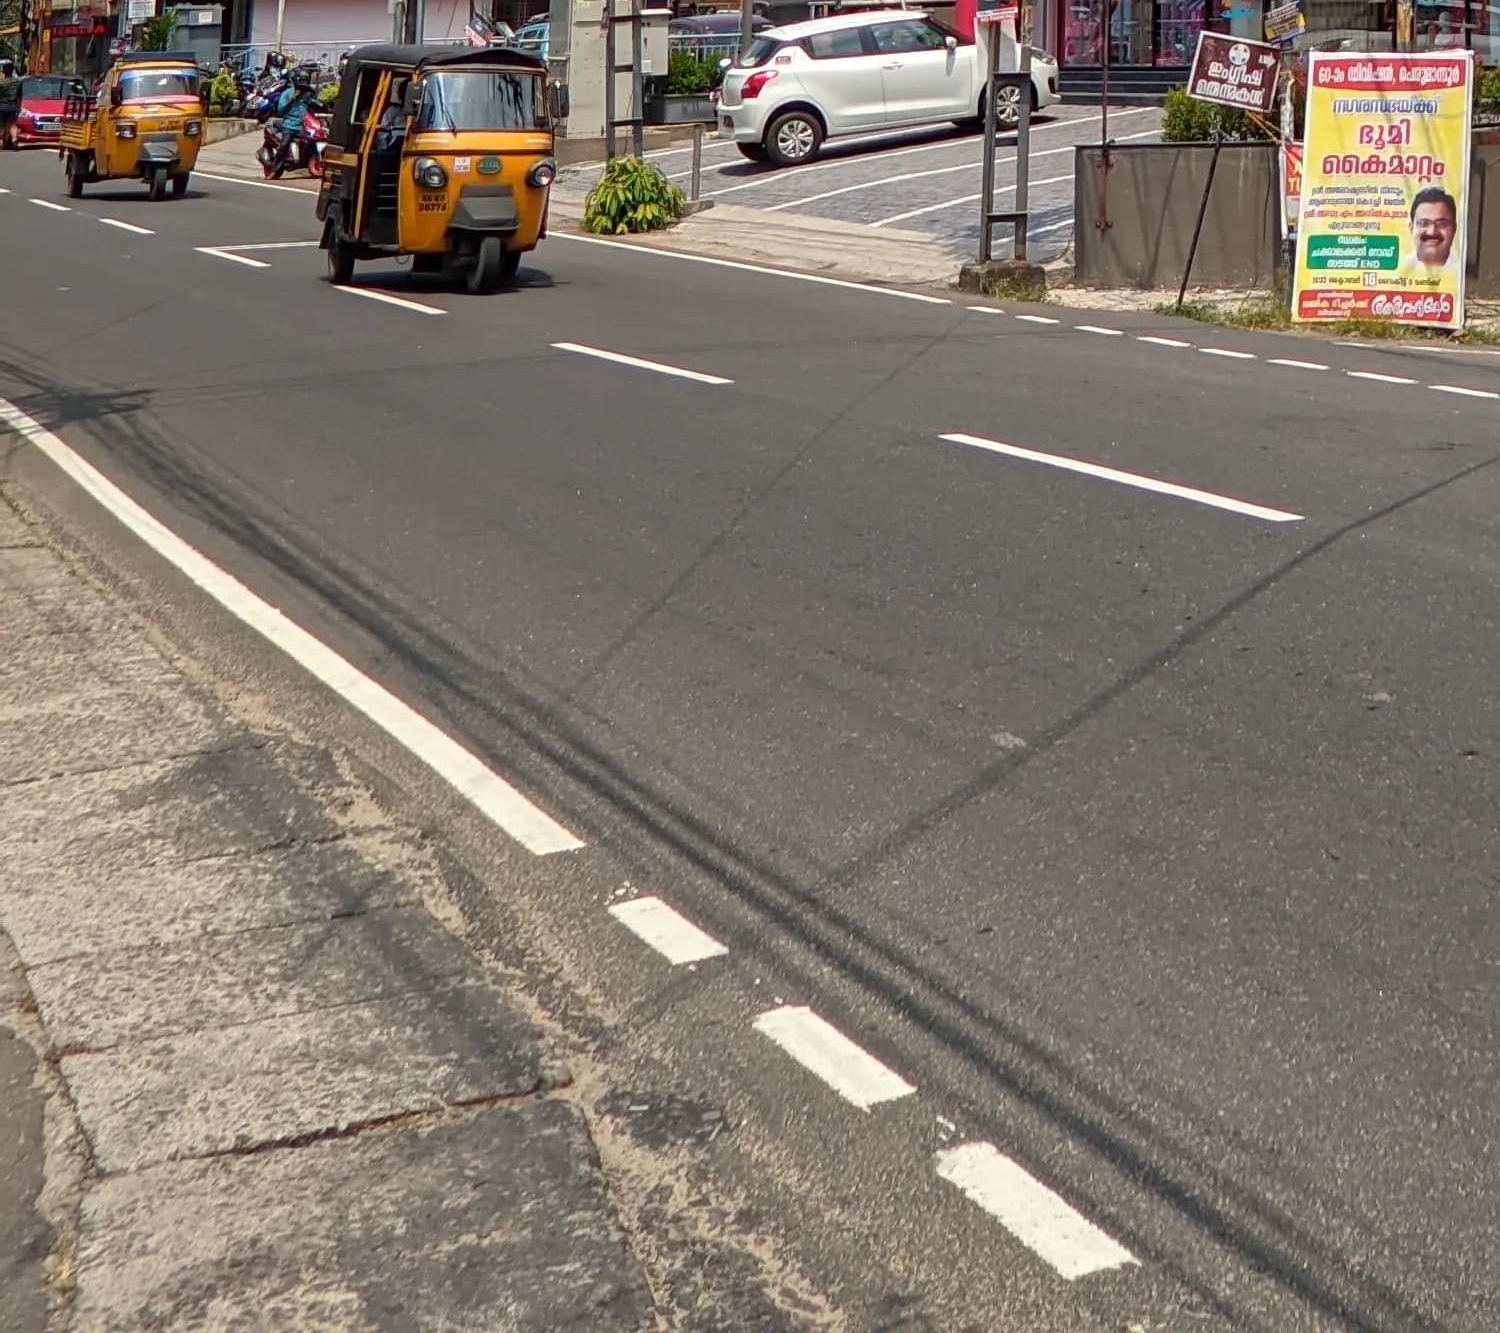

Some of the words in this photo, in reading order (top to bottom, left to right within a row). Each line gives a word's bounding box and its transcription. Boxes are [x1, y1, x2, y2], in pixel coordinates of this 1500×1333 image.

[1358, 117, 1412, 151] ഭൂമി
[1321, 153, 1446, 184] കൈമാറ്റം
[1361, 259, 1381, 269] END
[1363, 273, 1376, 286] 16
